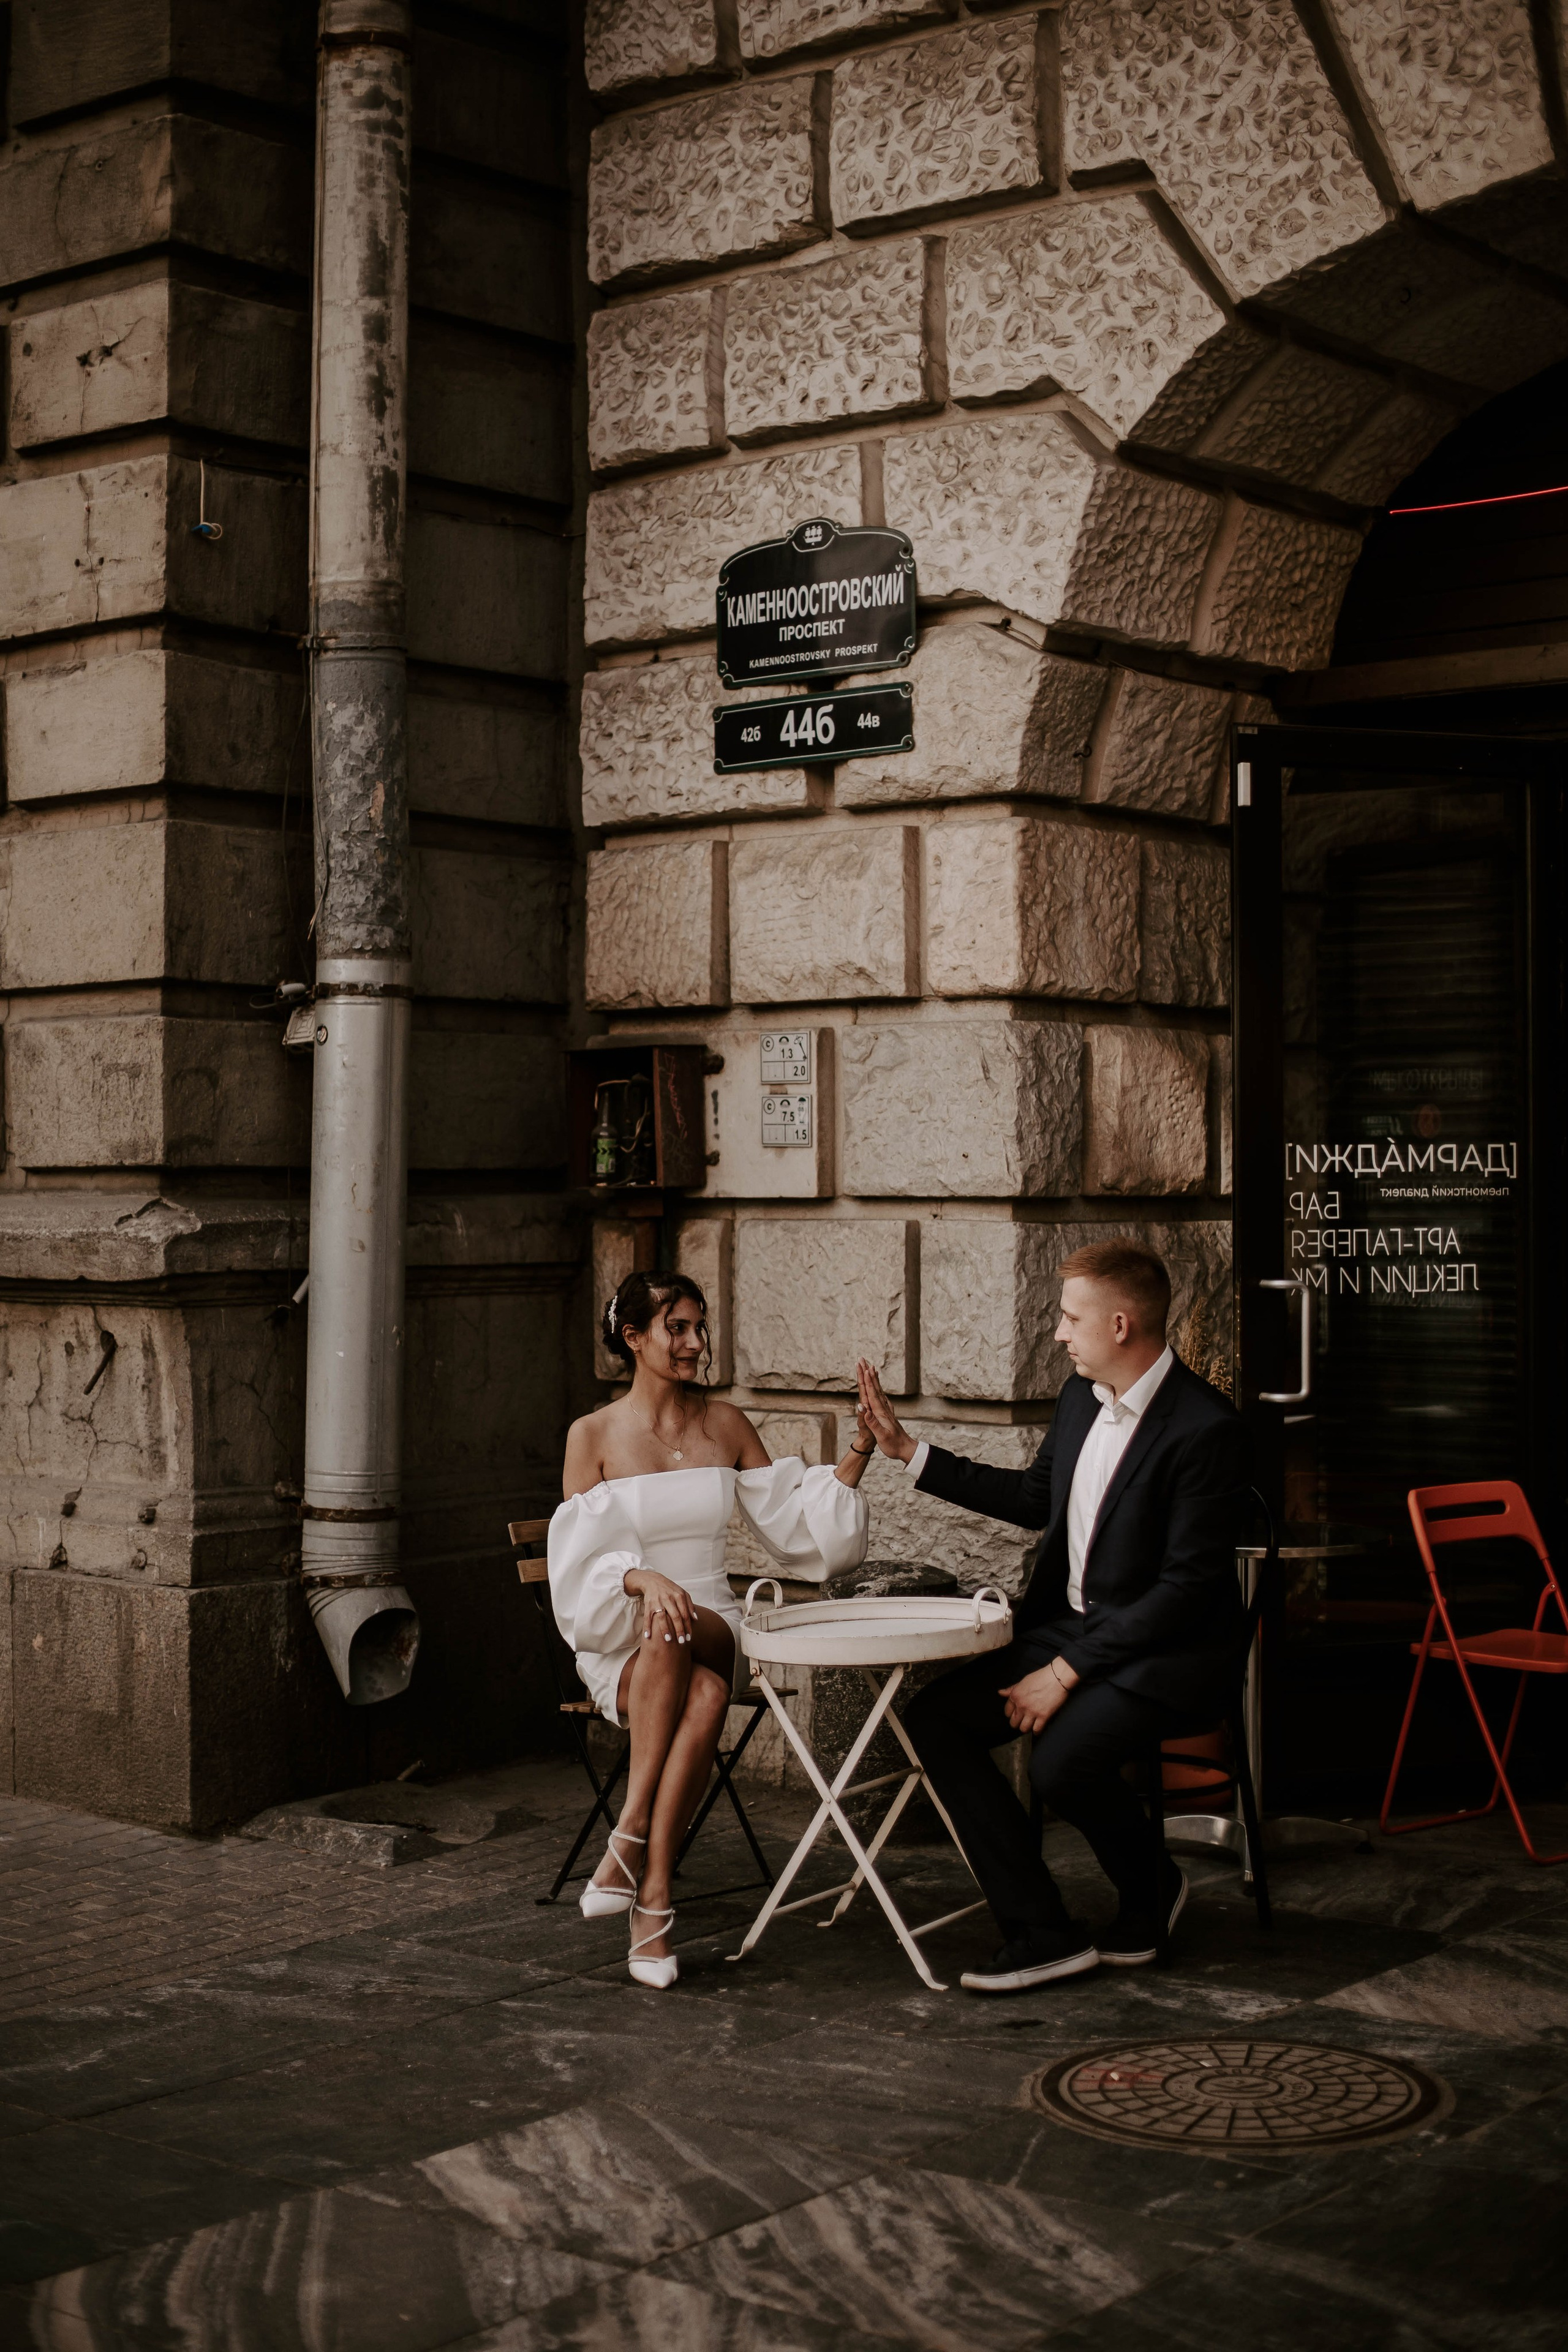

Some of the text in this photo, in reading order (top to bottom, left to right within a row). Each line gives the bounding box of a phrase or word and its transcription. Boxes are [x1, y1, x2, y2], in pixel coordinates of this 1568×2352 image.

[727, 564, 904, 627] КАМЕННООСТРОВСКИЙ
[778, 619, 845, 642] ПРОСПЕКТ
[749, 644, 878, 668] KAMENNOOSTROVSKY PROSPEKT
[782, 1049, 793, 1058] 1.3
[794, 1066, 805, 1076] 2.0
[782, 1112, 794, 1121] 7.5
[796, 1129, 807, 1139] 1.5
